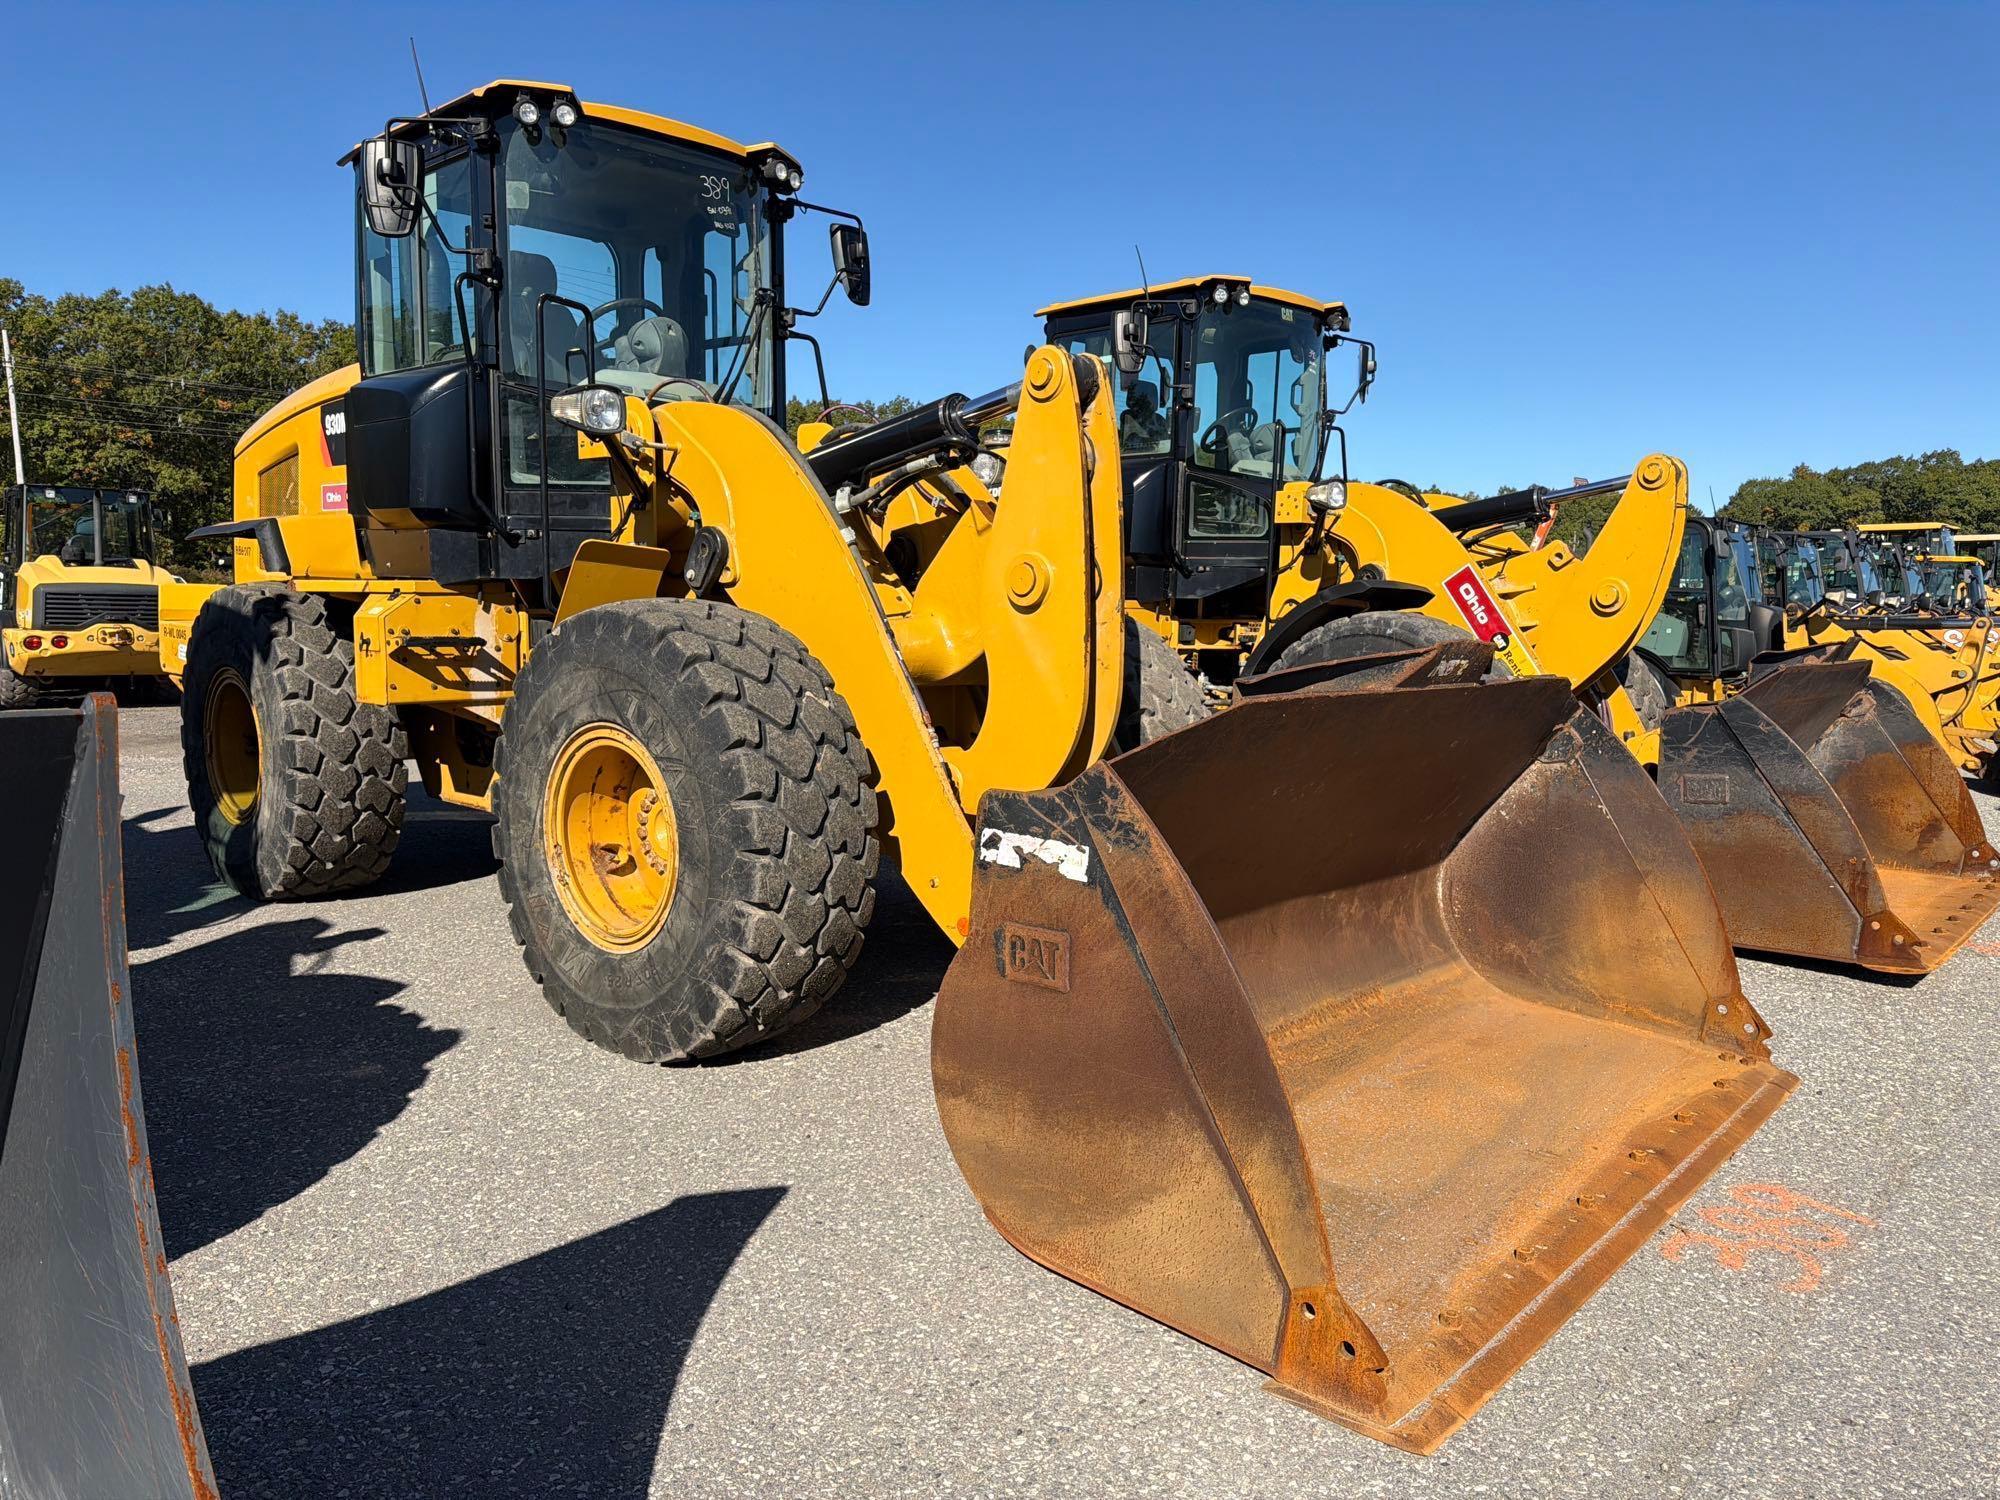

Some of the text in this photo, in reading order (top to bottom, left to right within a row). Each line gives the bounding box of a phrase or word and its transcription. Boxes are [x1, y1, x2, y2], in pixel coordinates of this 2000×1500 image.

[700, 175, 730, 202] 389
[1281, 307, 1294, 321] CAT
[326, 492, 342, 503] Ohio
[1458, 582, 1489, 625] Ohio
[1492, 634, 1507, 649] CAT
[1009, 935, 1060, 981] CAT
